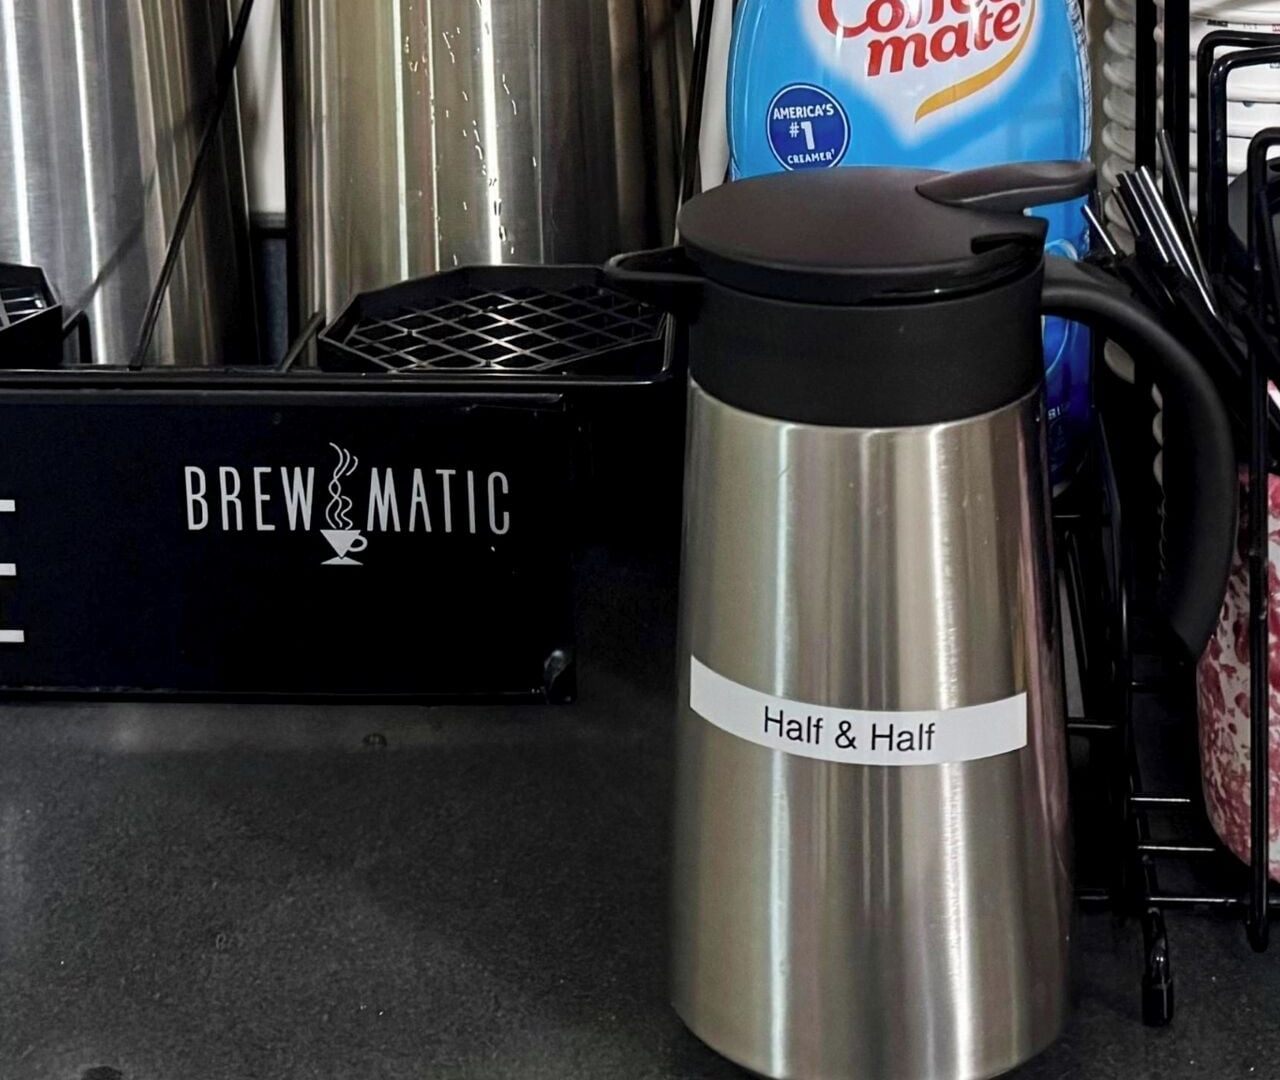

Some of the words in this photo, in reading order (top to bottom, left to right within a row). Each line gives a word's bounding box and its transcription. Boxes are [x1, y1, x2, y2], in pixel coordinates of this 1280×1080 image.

[772, 103, 835, 121] AMERICA'S
[788, 120, 816, 151] #1
[183, 465, 316, 533] BREW
[366, 468, 512, 536] MATIC
[763, 706, 823, 745] Half
[834, 721, 858, 751] &
[870, 723, 937, 752] Half
